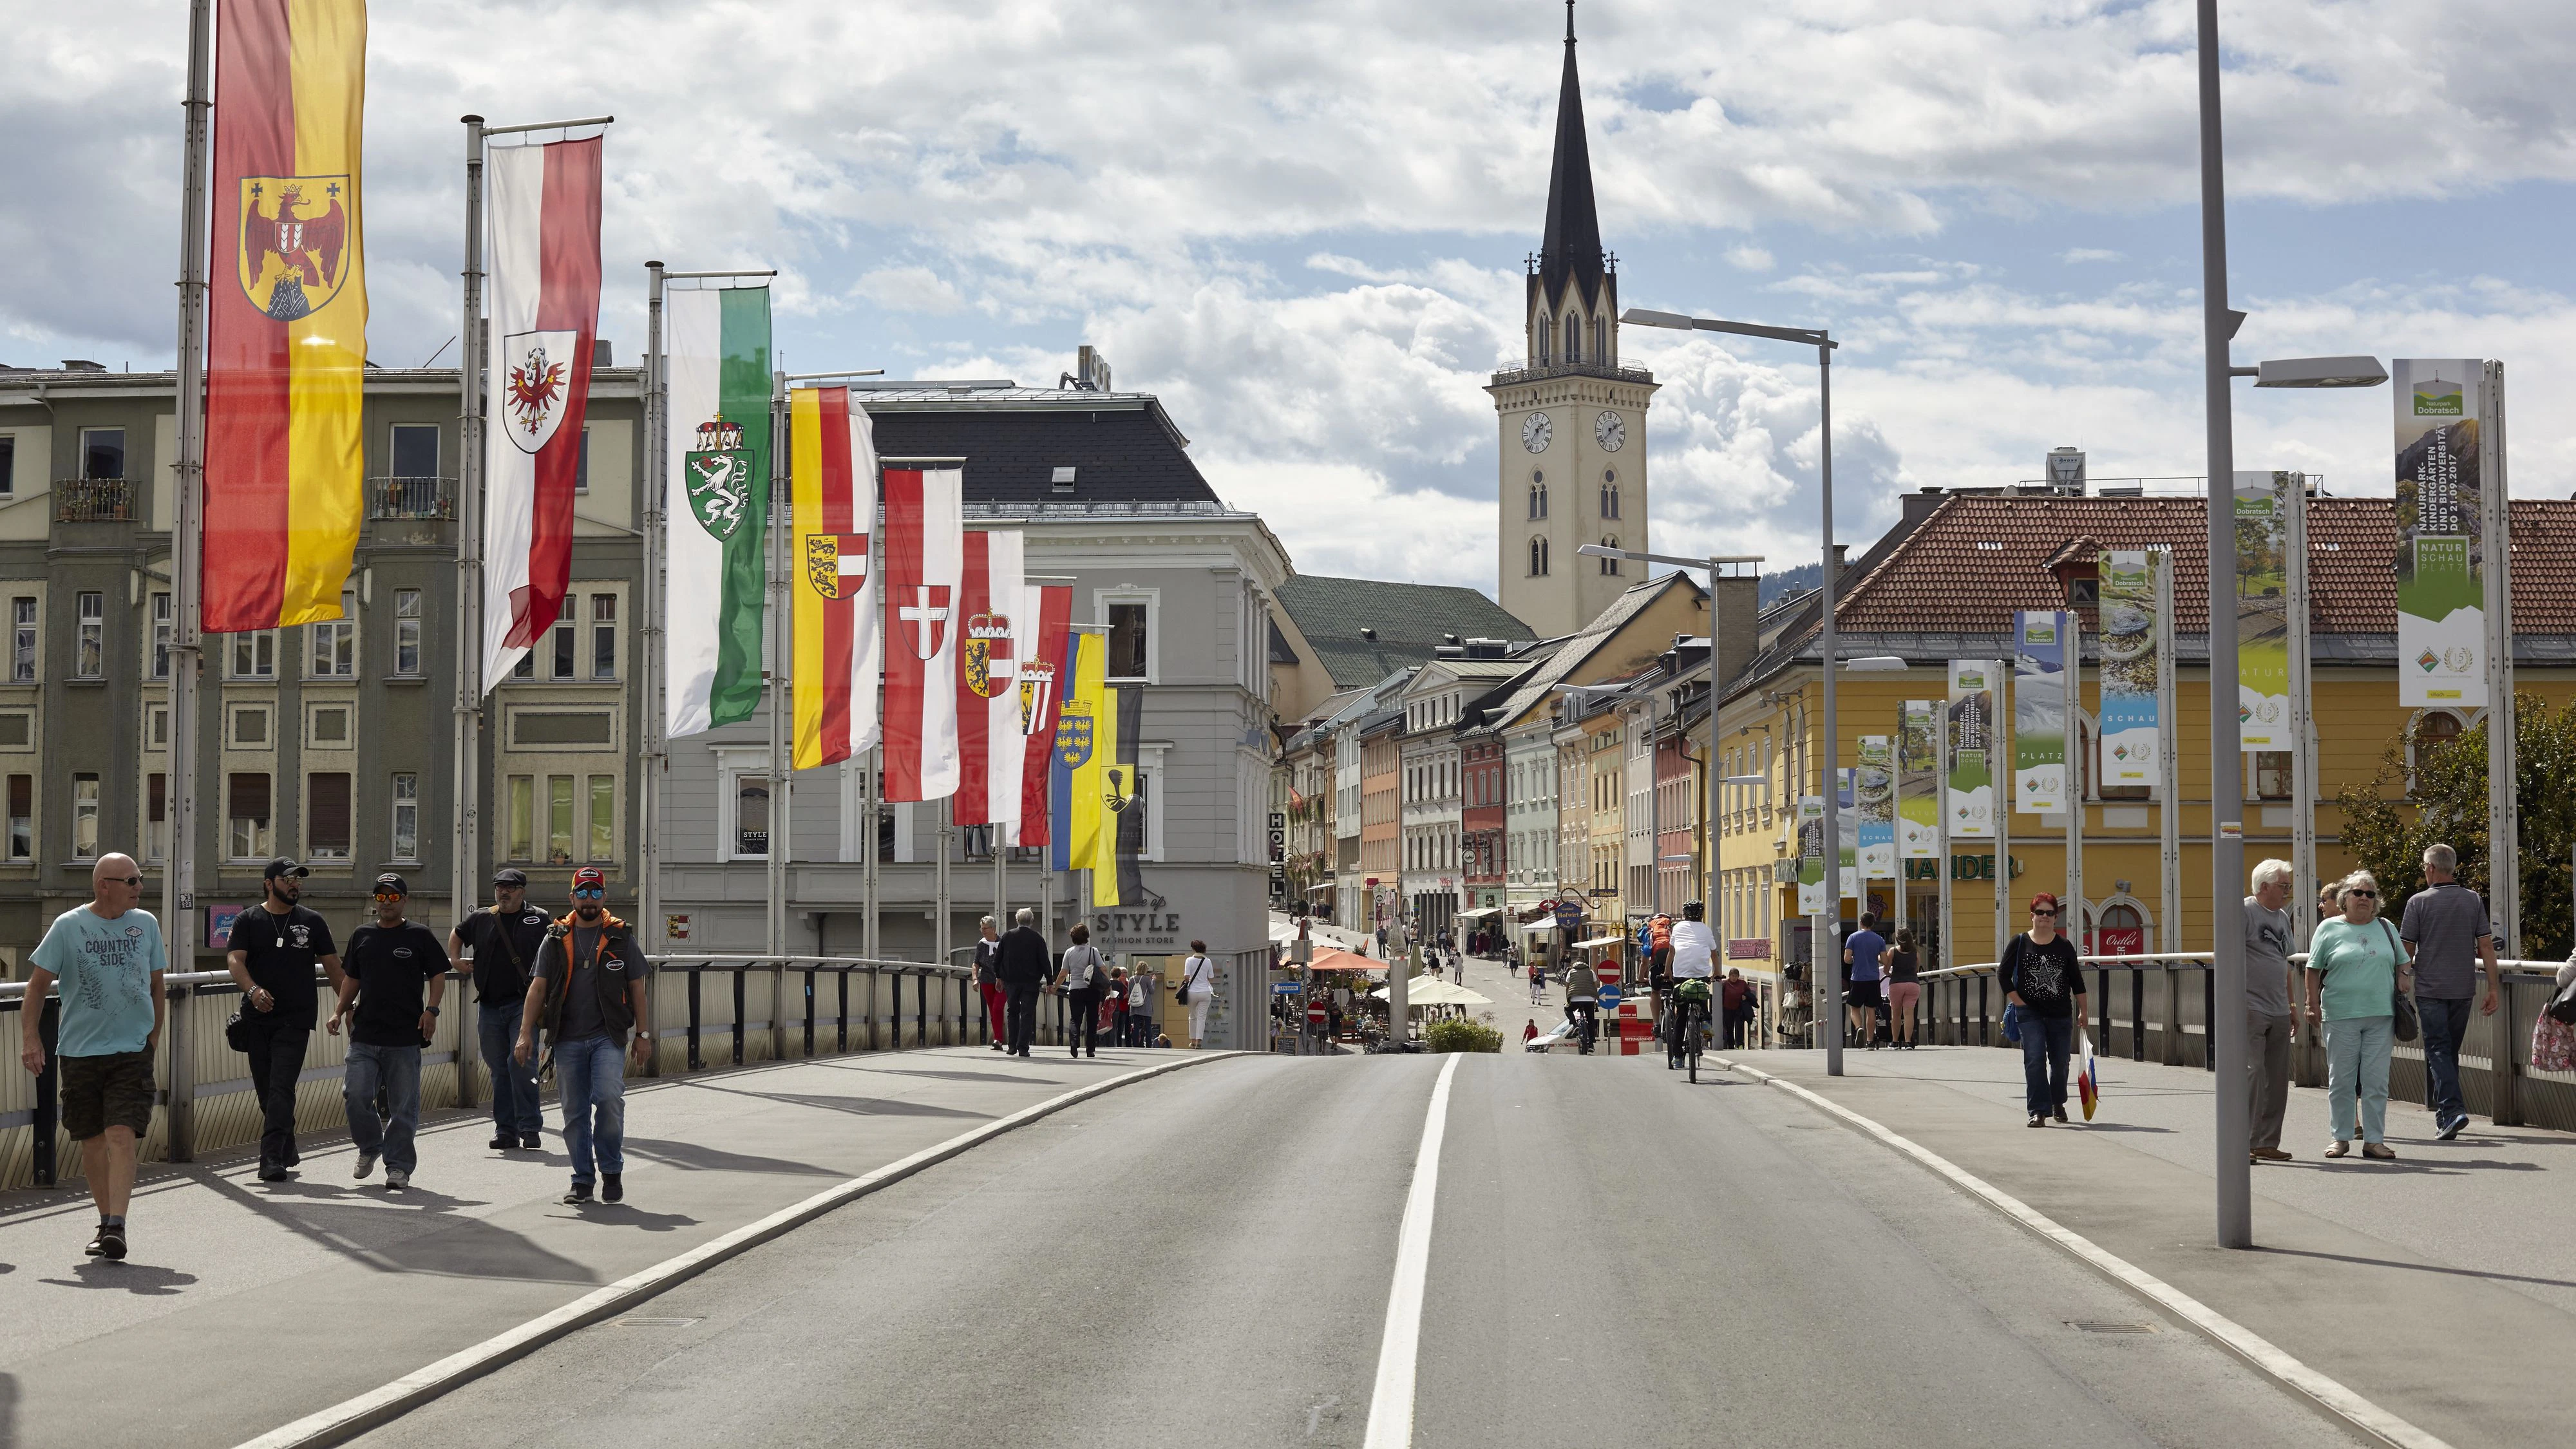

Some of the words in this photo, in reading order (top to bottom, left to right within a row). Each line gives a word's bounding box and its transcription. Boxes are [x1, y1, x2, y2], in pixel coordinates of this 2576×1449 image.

[2436, 422, 2447, 504] BIODIVERSITÄT
[2426, 446, 2438, 531] KINDERGÄRTEN
[2448, 454, 2458, 512] 21.09.2017
[2419, 462, 2427, 531] NATURPARK-
[2439, 507, 2448, 531] UND
[2450, 515, 2458, 531] DO
[2421, 544, 2463, 552] NATUR
[2421, 553, 2463, 562] SCHAU
[2421, 564, 2463, 573] PLATZ
[1975, 739, 1980, 747] DO
[1150, 896, 1167, 911] of
[1097, 913, 1179, 932] STYLE
[2106, 931, 2137, 945] Outlet
[86, 940, 137, 953] COUNTRY
[100, 953, 126, 966] SIDE
